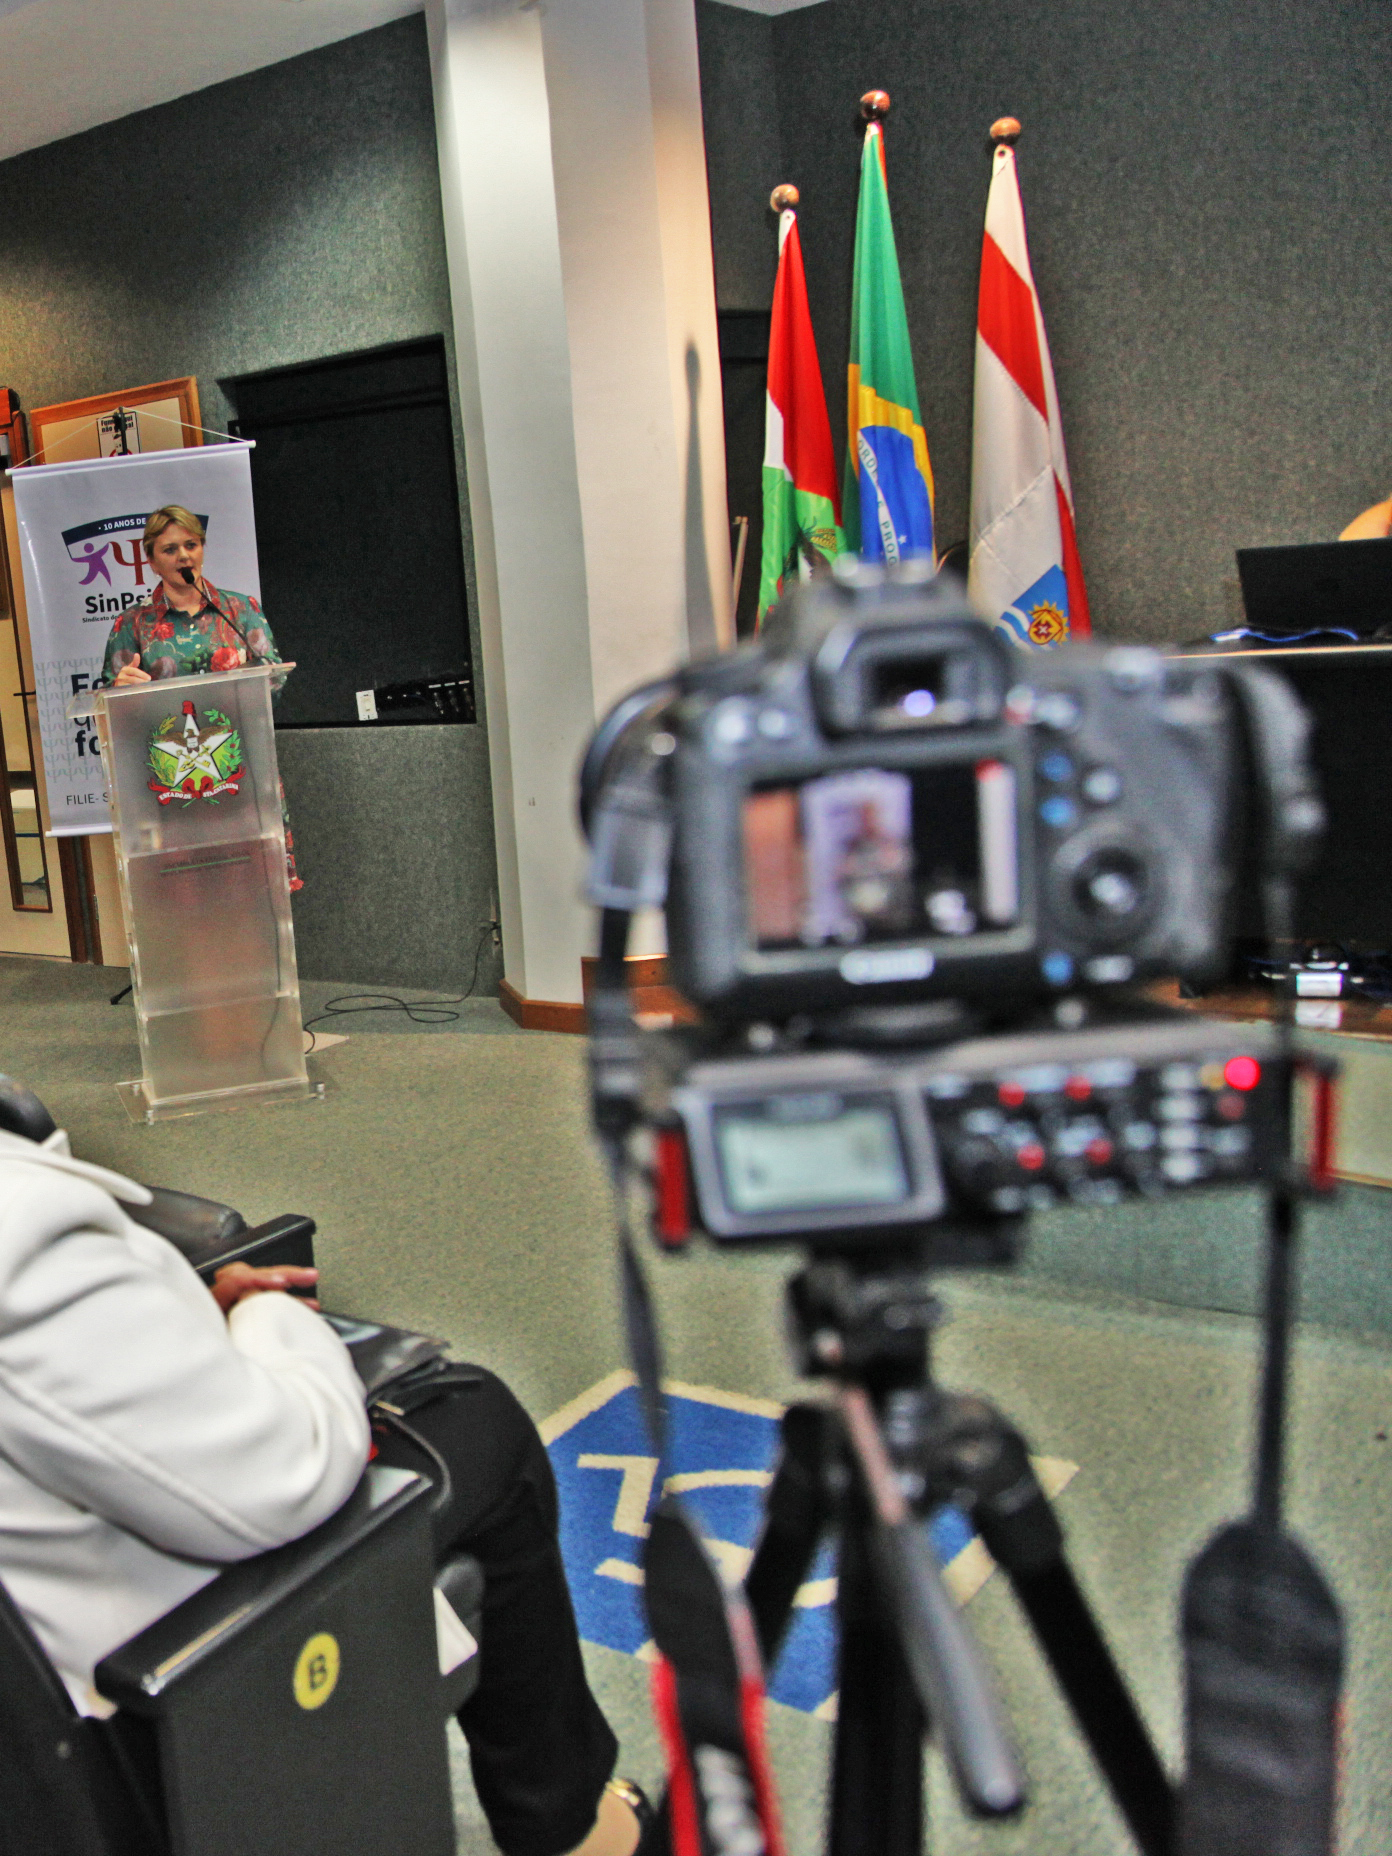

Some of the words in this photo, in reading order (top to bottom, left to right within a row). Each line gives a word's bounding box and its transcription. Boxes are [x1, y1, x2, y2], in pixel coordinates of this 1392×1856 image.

[103, 523, 113, 531] 10
[114, 518, 135, 529] ANOS
[136, 517, 146, 525] DE
[158, 791, 184, 801] ESTADO
[308, 1653, 327, 1691] B
